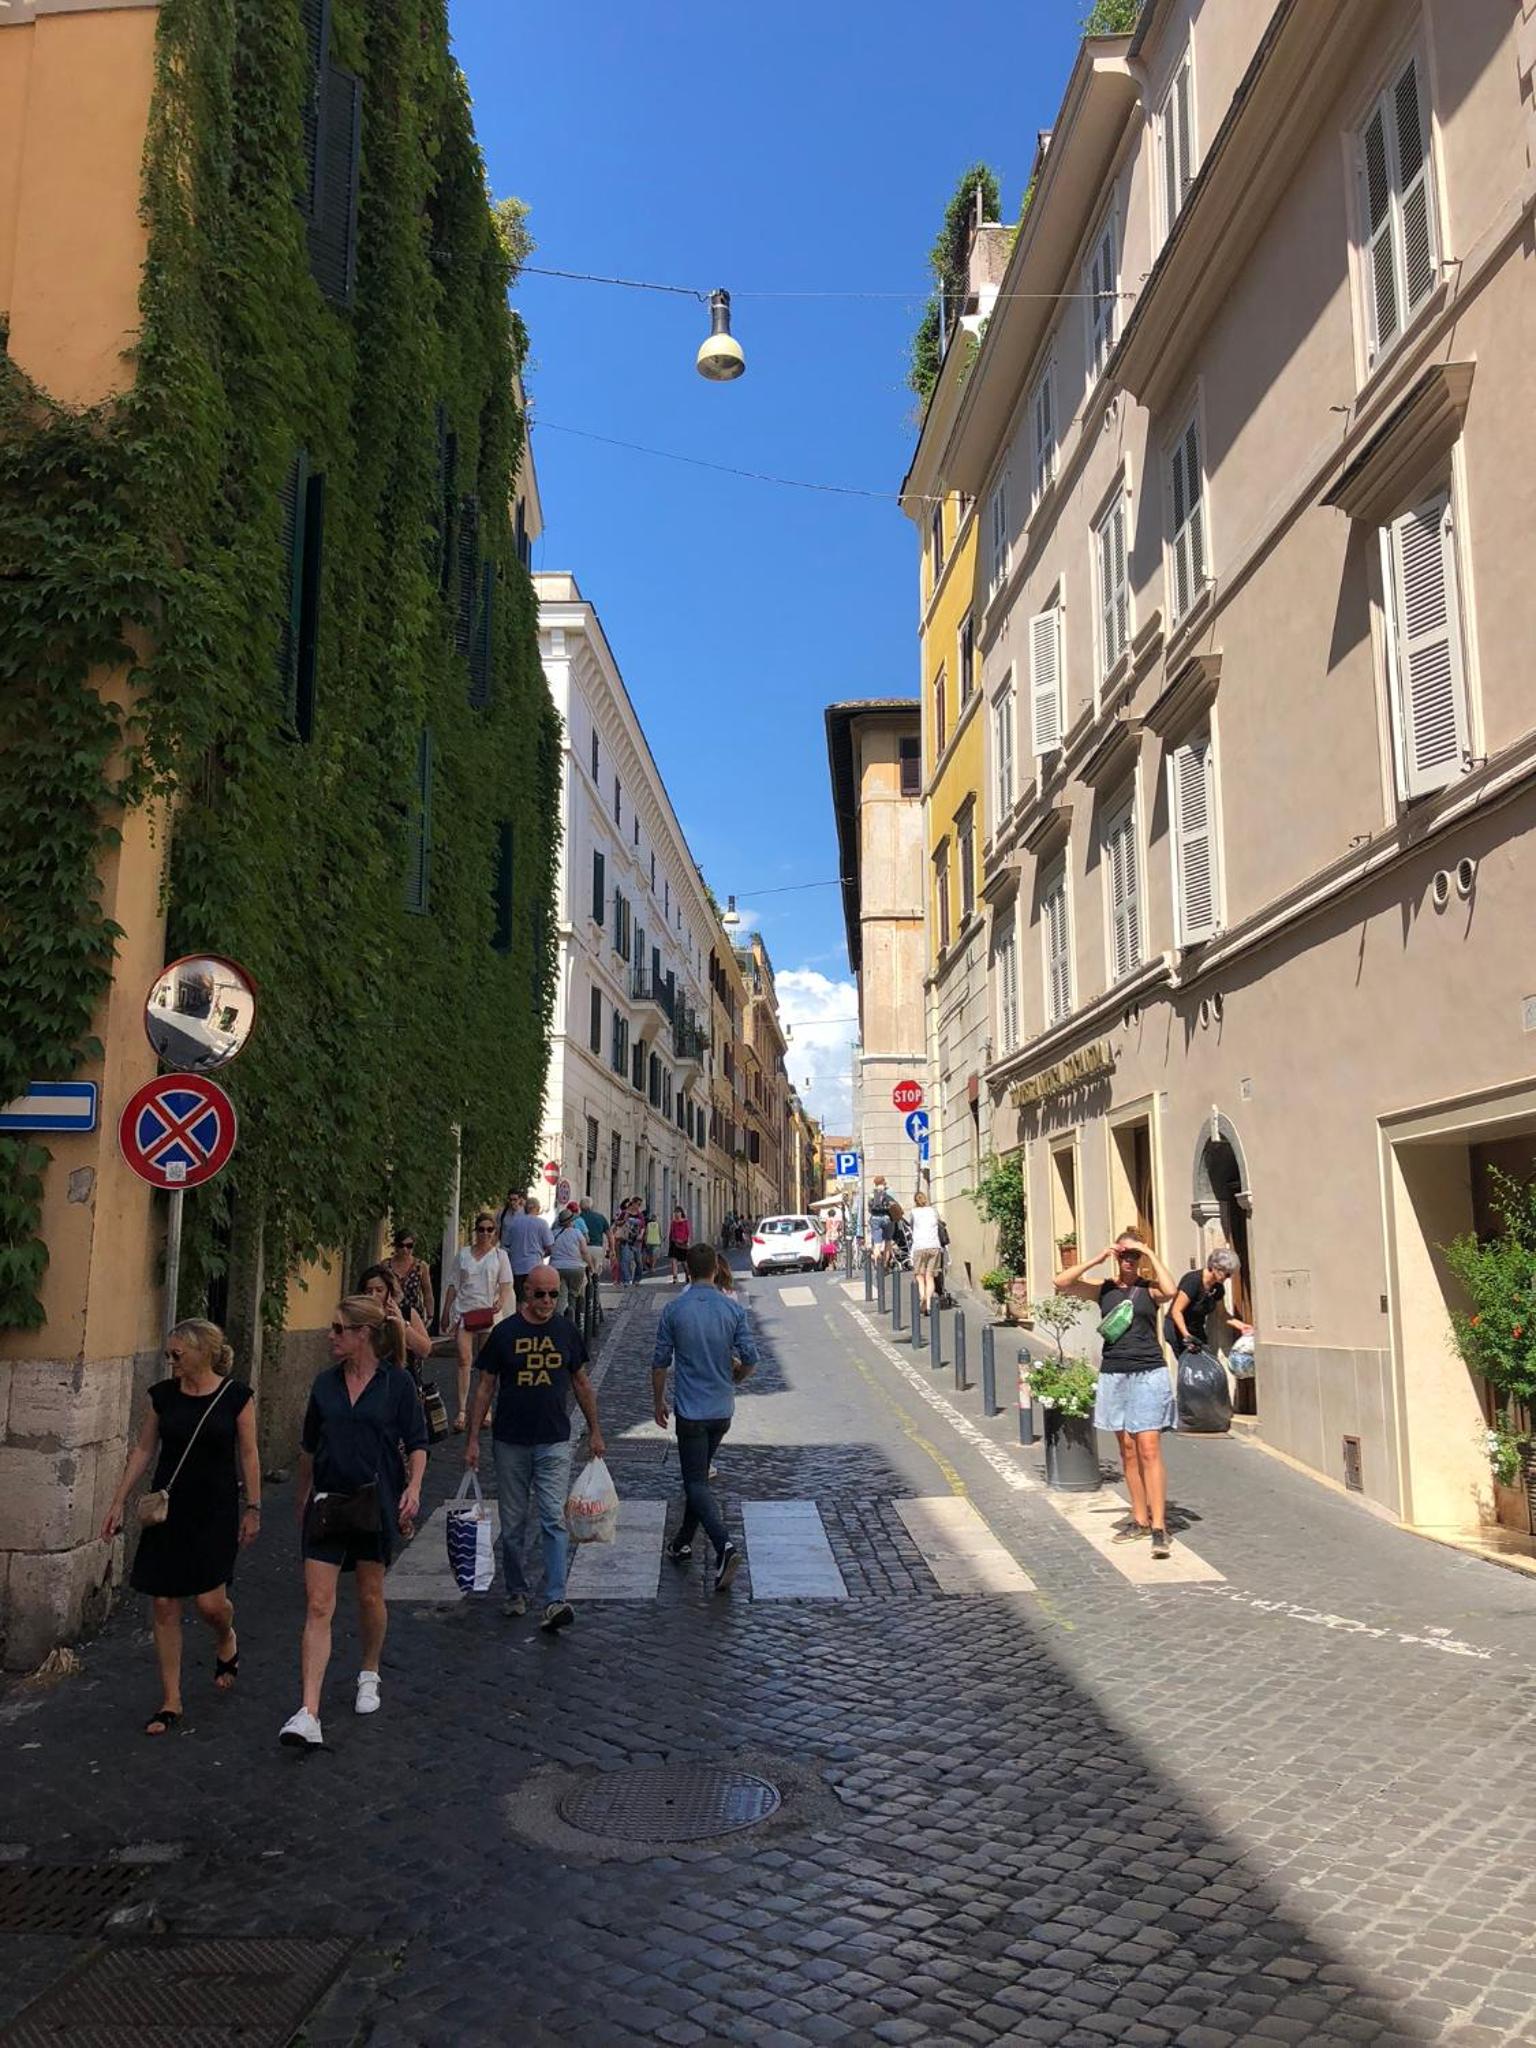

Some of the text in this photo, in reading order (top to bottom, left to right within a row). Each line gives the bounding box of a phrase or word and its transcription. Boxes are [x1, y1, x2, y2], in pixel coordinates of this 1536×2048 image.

[895, 1090, 921, 1102] STOP
[840, 1154, 855, 1174] P
[515, 1336, 555, 1353] DIA
[527, 1353, 562, 1369] DO
[517, 1370, 551, 1386] RA
